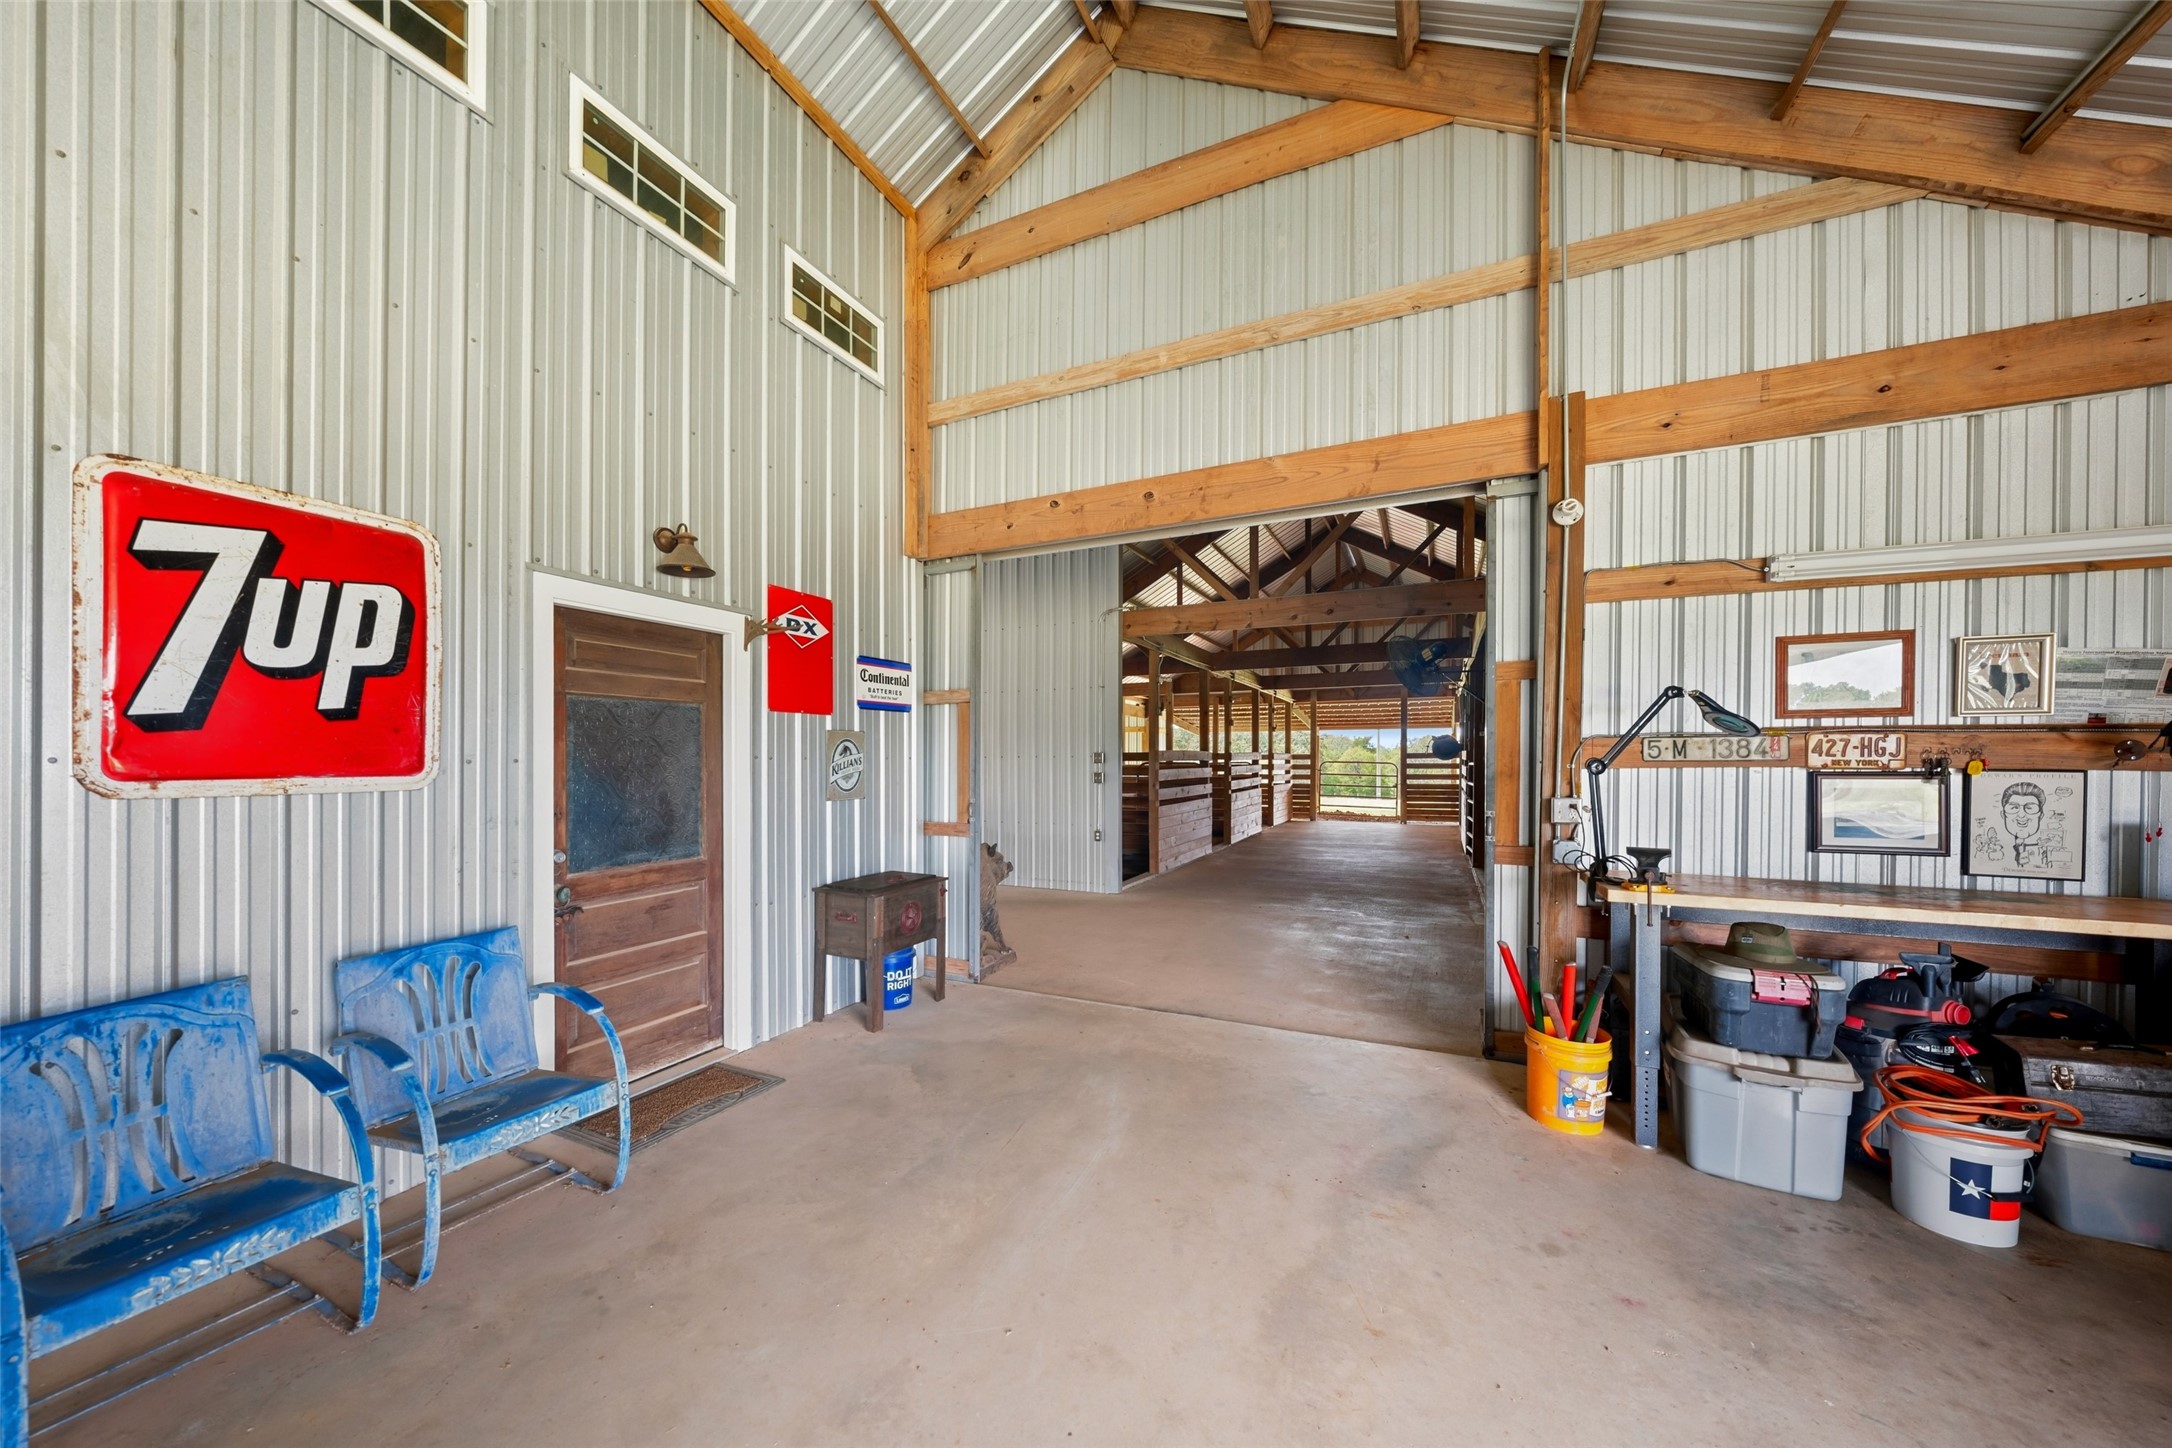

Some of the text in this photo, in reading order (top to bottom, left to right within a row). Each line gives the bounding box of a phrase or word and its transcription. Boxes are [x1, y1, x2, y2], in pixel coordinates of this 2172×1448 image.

[860, 668, 910, 687] Continental
[867, 687, 903, 696] BATTERIES
[1709, 737, 1769, 759] 1384
[1811, 736, 1902, 758] 427-HGJ
[1831, 759, 1881, 767] NEW YORK
[887, 966, 912, 981] DO IT
[887, 977, 912, 991] RIGHT
